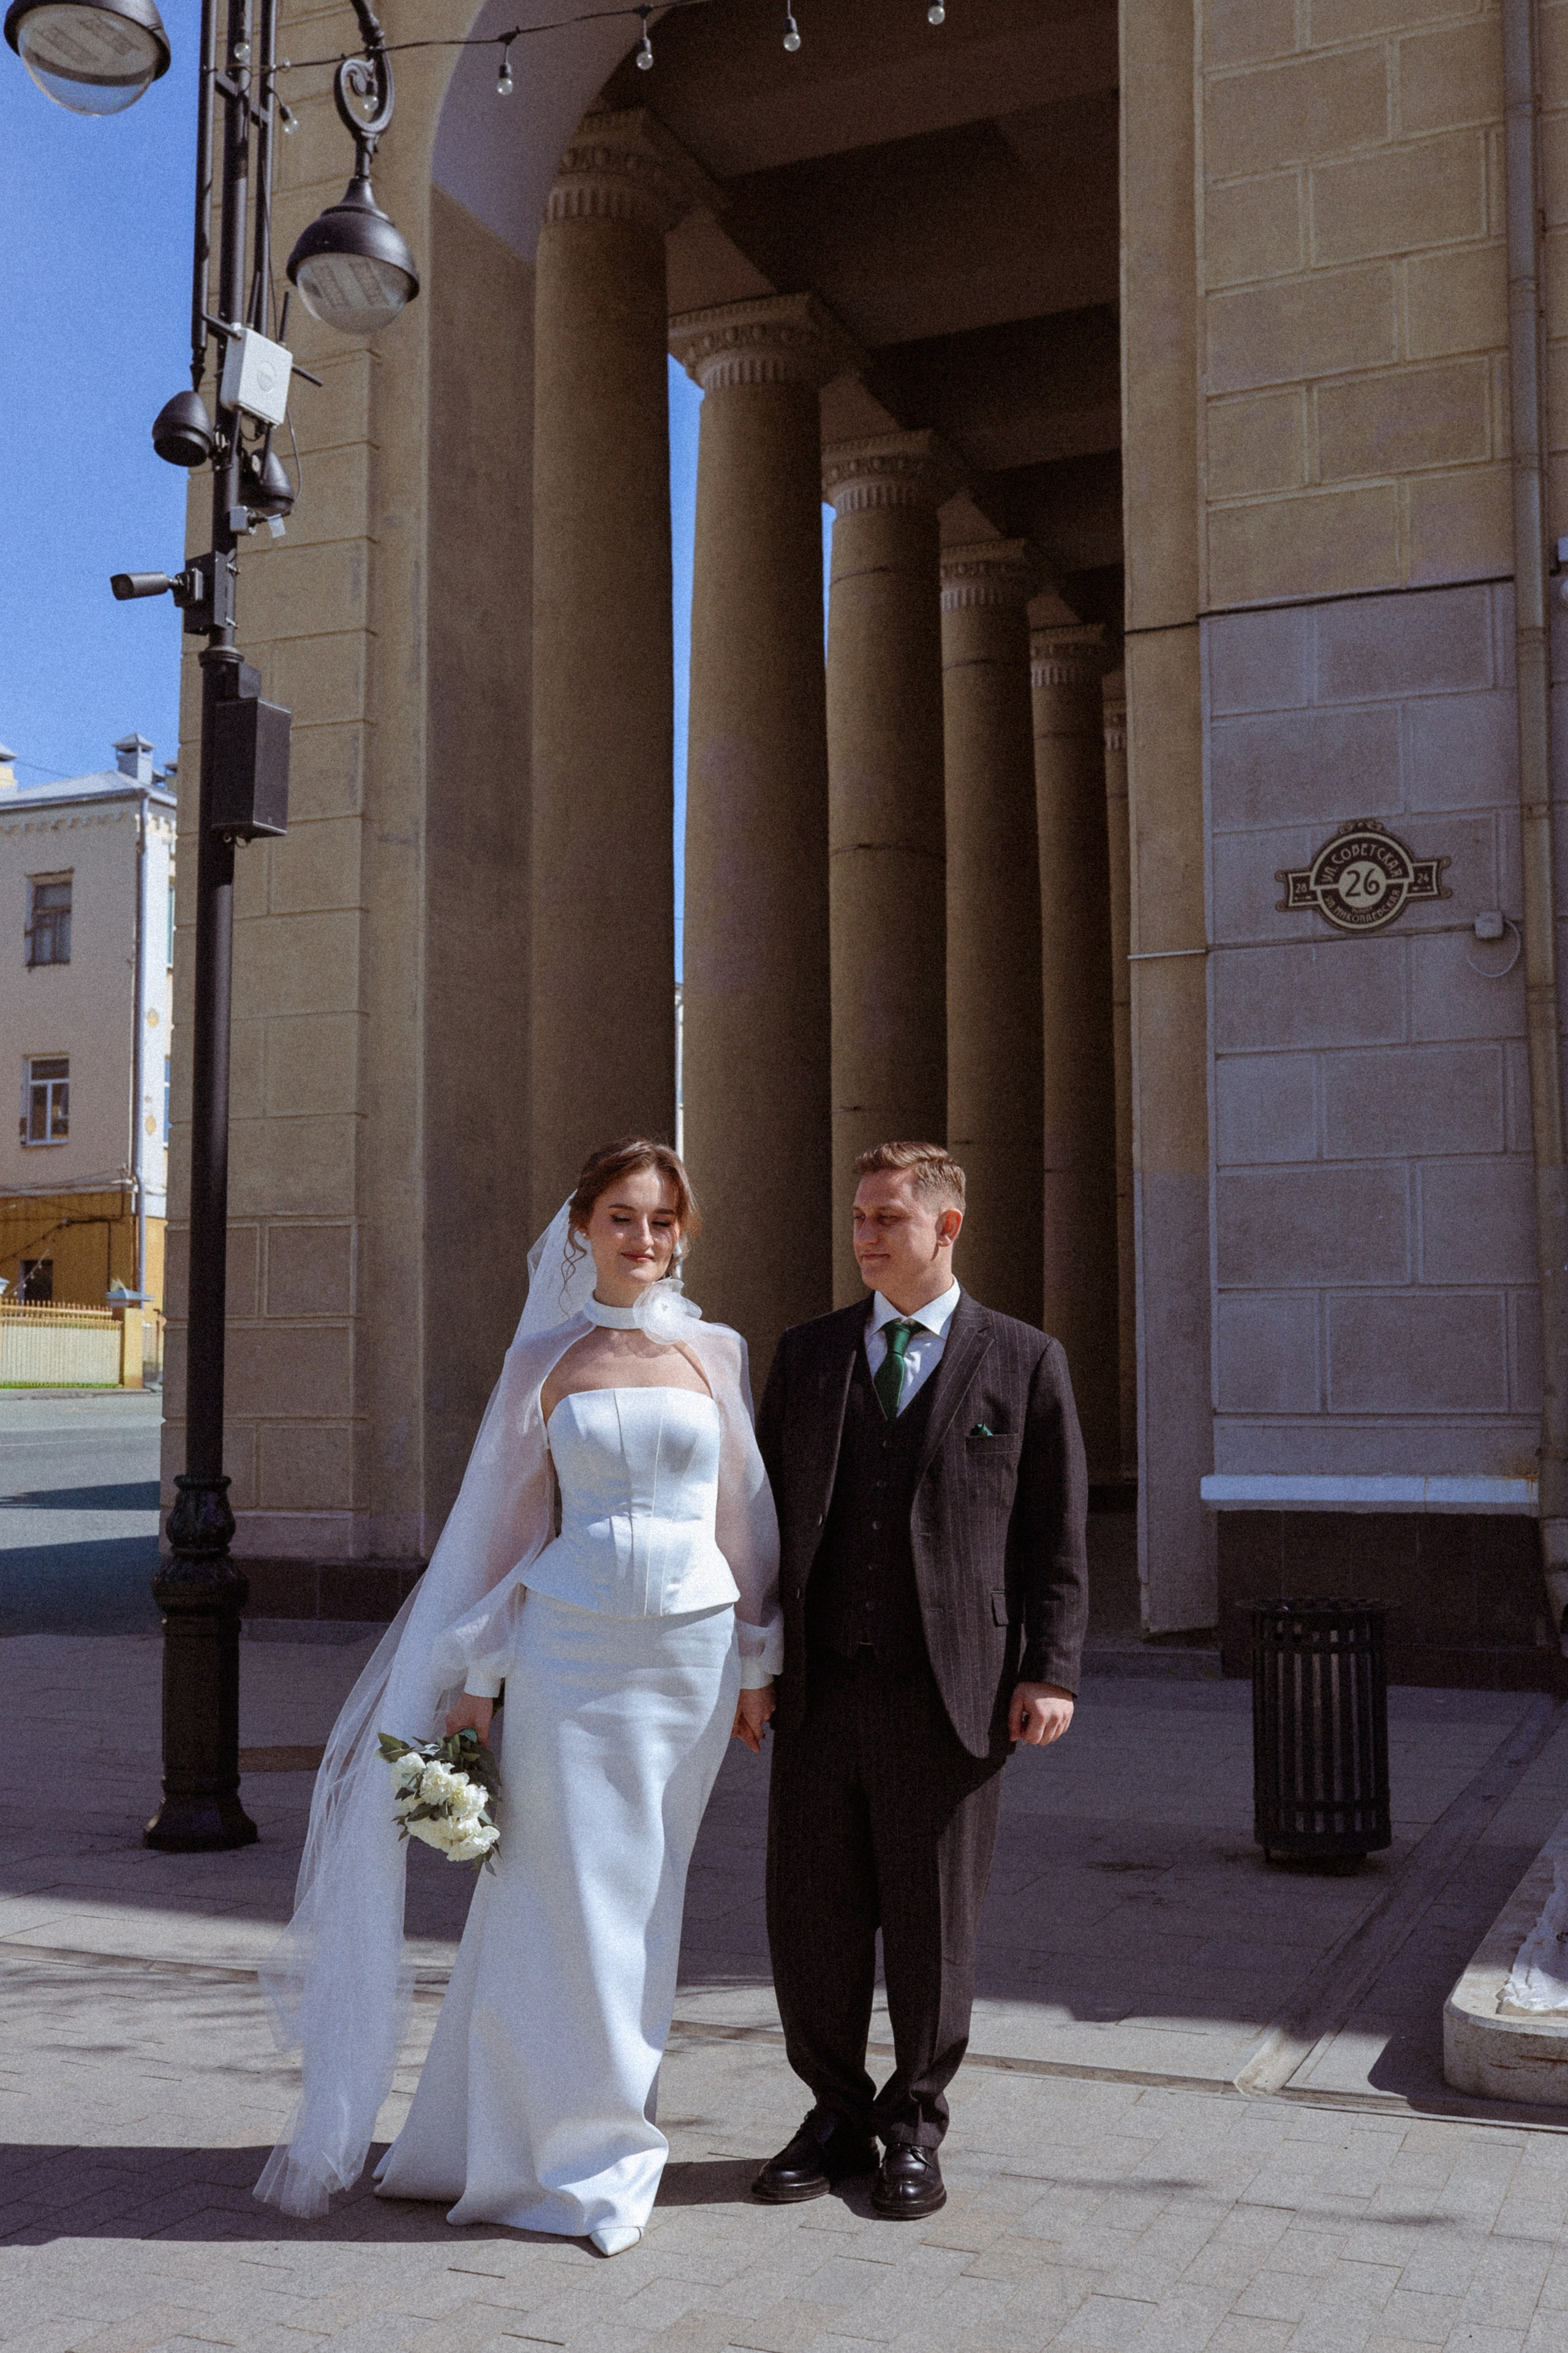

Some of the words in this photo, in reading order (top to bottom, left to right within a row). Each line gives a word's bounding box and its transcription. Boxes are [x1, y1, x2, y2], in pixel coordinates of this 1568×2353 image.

[1331, 843, 1403, 877] СОВЕТСКАЯ
[1344, 867, 1380, 897] 26
[1417, 872, 1429, 884] 24
